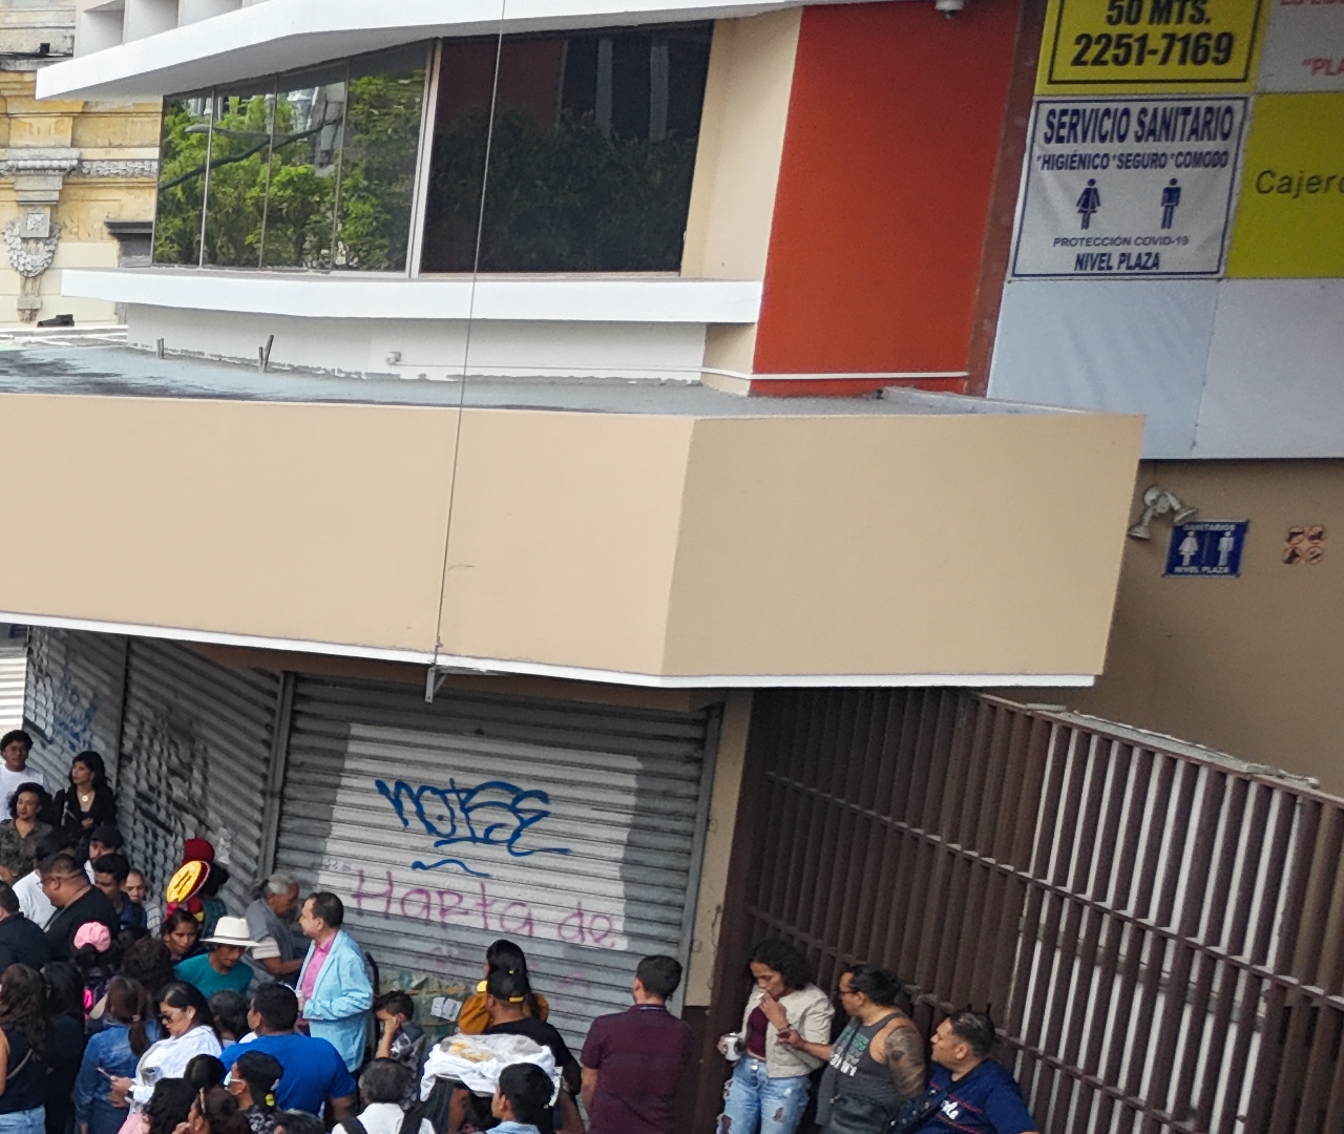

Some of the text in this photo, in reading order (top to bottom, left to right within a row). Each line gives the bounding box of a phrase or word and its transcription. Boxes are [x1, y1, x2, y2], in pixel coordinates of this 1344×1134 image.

[1070, 31, 1234, 67] 2251-7169
[1043, 105, 1234, 144] SERVICIO SANITARIO
[1053, 235, 1189, 248] PROTECCIÓN COVID-19
[1074, 252, 1160, 272] NIVEL PLAZA
